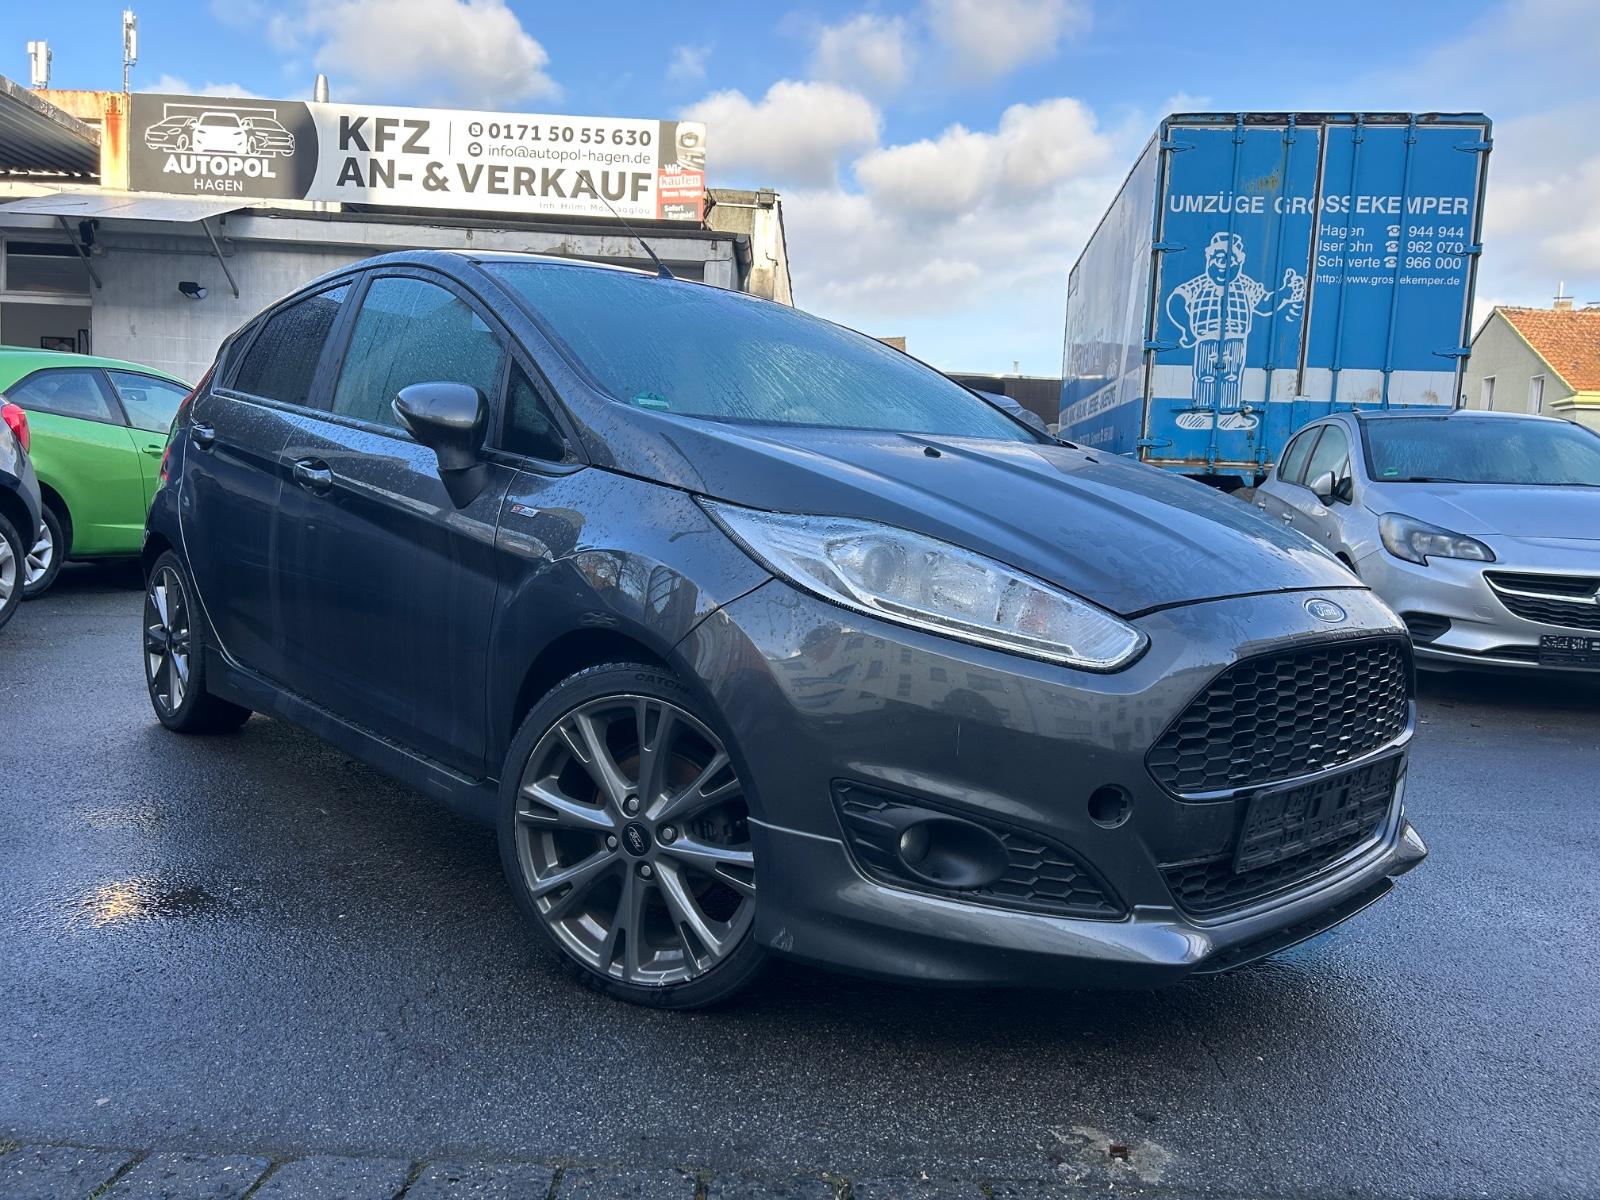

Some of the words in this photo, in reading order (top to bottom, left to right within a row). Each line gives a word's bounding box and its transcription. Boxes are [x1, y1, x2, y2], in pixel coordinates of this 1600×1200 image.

[339, 116, 430, 154] KFZ
[488, 123, 542, 141] 0171
[548, 126, 574, 142] 50
[580, 128, 605, 144] 55
[612, 129, 651, 146] 630
[488, 145, 651, 165] info@autopol-hagen.de
[163, 154, 276, 178] AUTOPOL
[193, 178, 243, 192] HAGEN
[336, 157, 413, 188] AN-
[422, 161, 450, 192] &
[457, 163, 652, 202] VERKAUF
[661, 174, 699, 186] kaufen
[1170, 191, 1264, 214] UMZÜGE
[1320, 224, 1365, 239] Hagen
[1408, 226, 1433, 237] 944
[1438, 226, 1464, 238] 944
[1319, 239, 1373, 253] Iserohn
[1407, 241, 1432, 253] 962
[1436, 241, 1464, 254] 070
[1405, 256, 1431, 269] 966
[1435, 257, 1462, 269] 000
